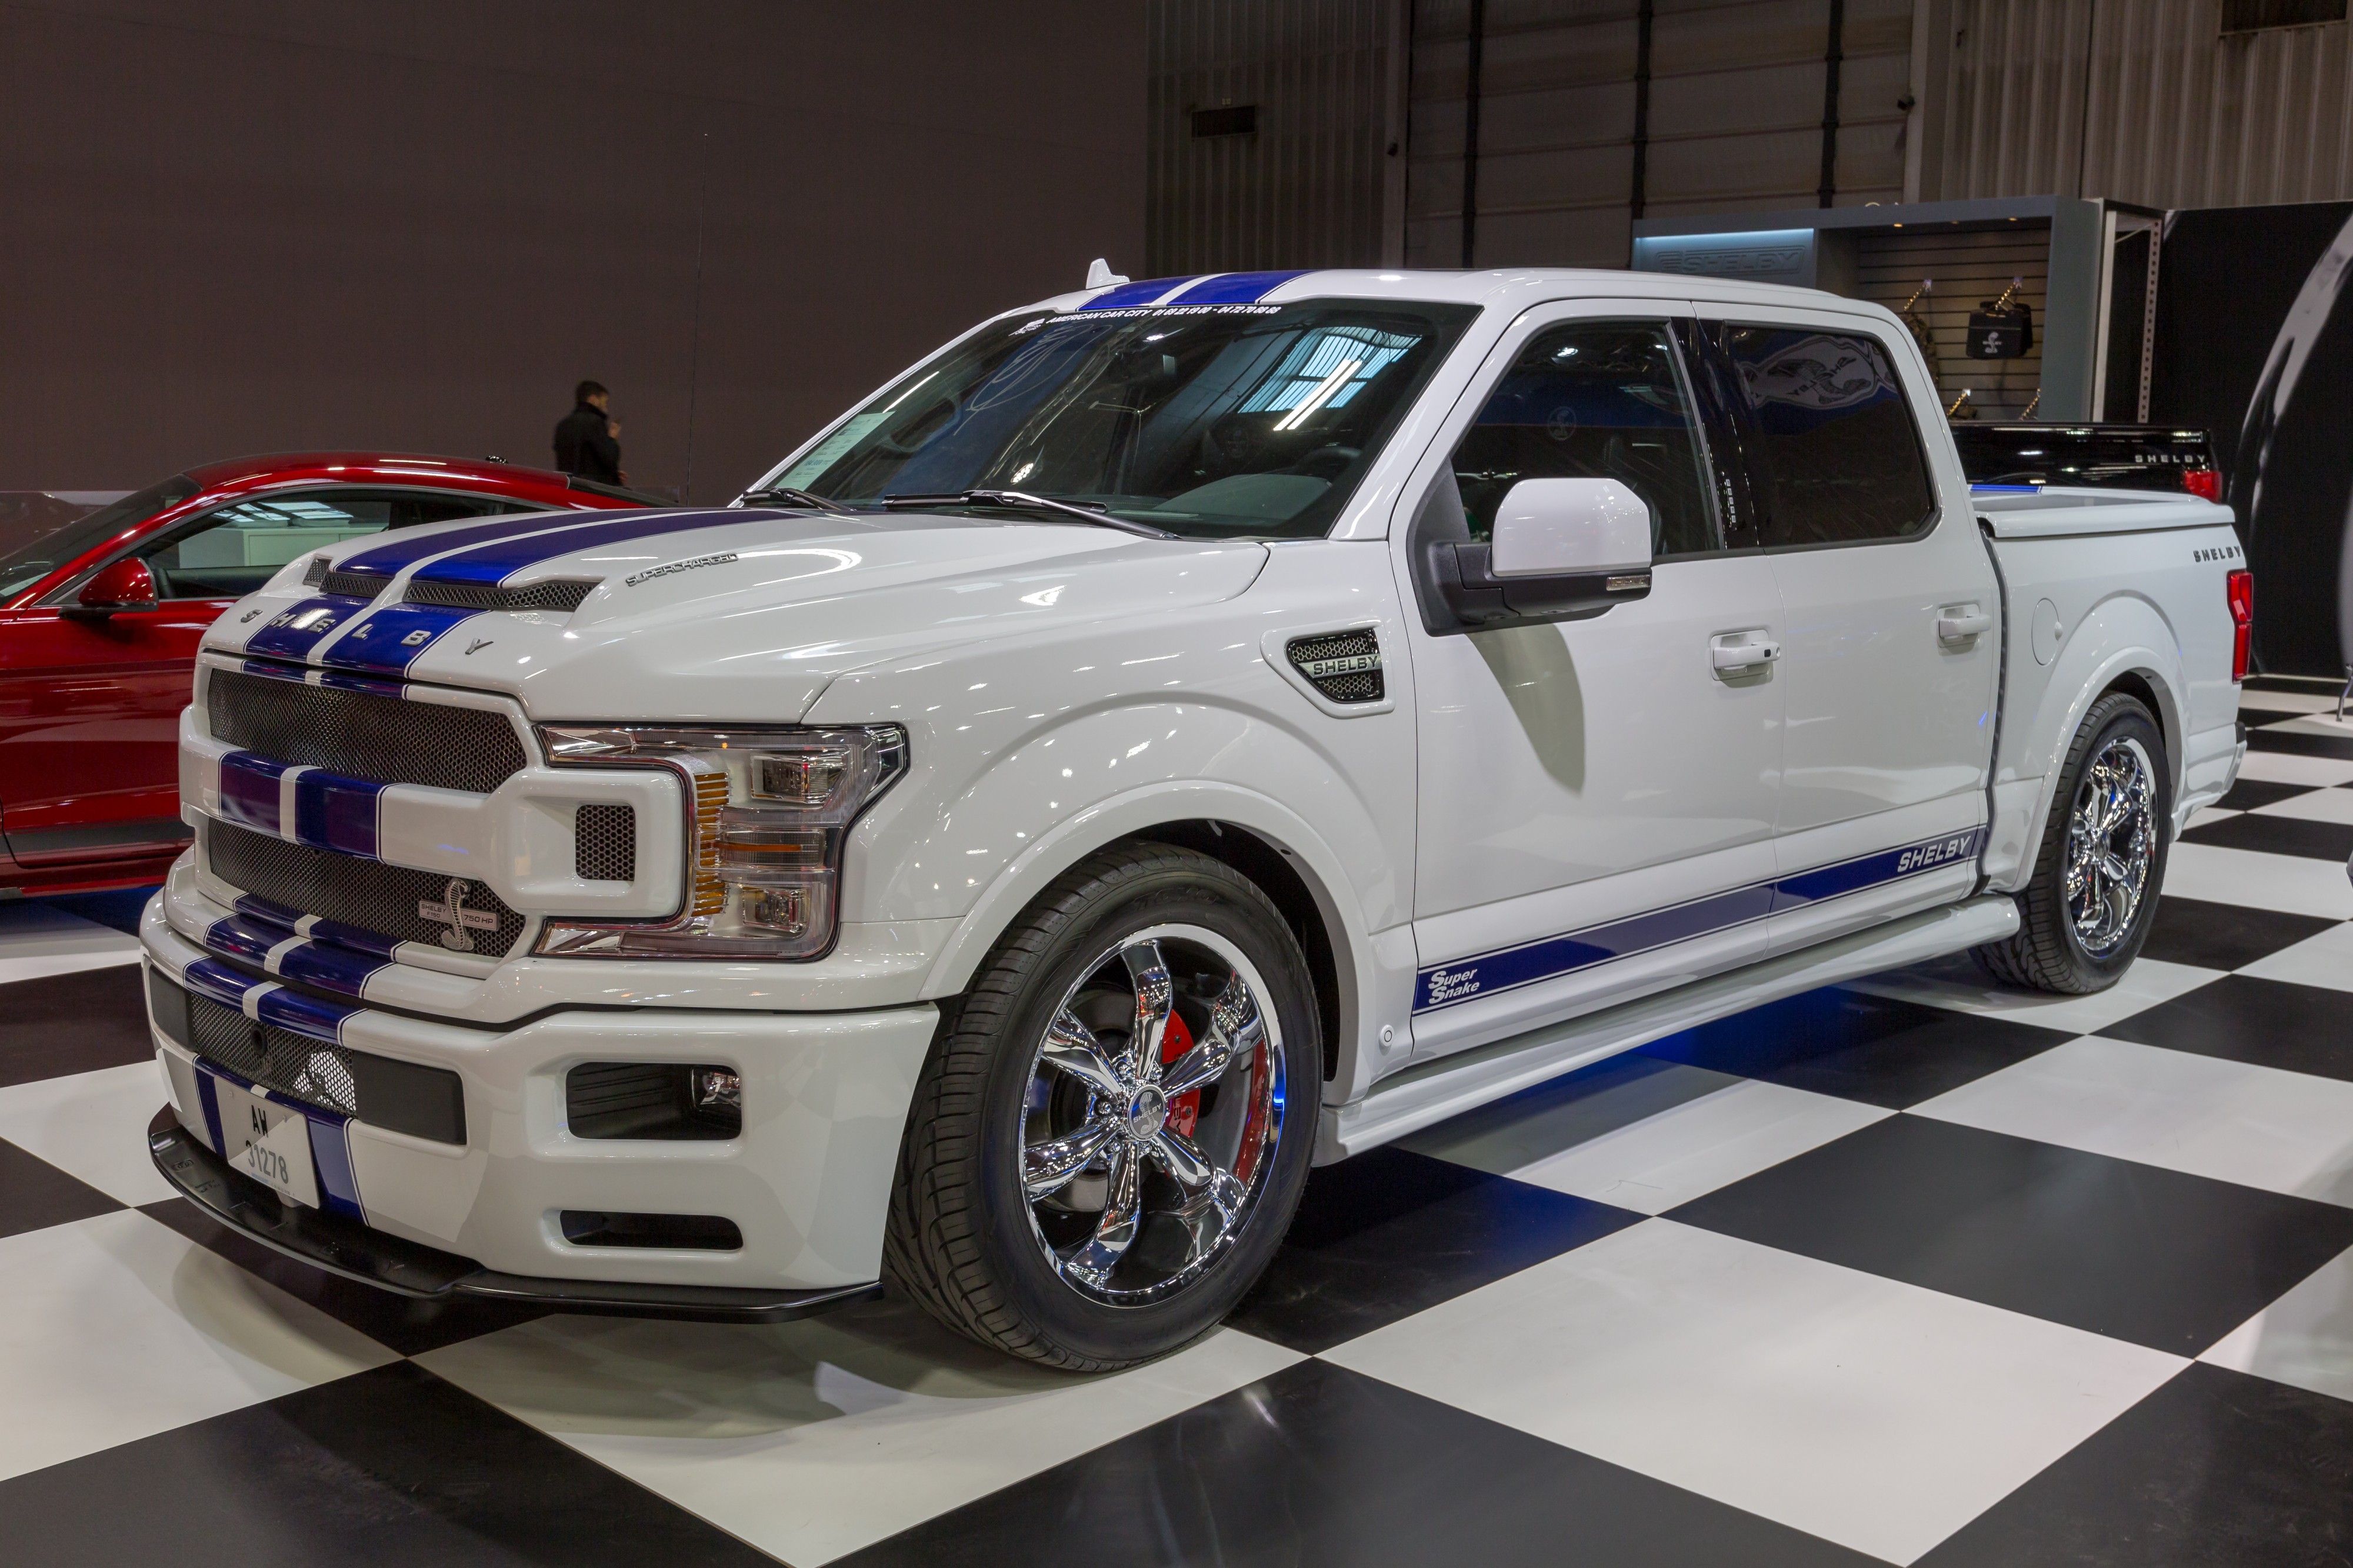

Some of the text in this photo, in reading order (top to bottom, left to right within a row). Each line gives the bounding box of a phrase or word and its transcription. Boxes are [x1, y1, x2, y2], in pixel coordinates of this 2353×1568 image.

[1683, 252, 1799, 273] SHELBY
[1046, 312, 1101, 323] AMERICAN
[2135, 454, 2206, 463] SHELBY
[2193, 546, 2242, 563] SHELBY
[625, 552, 739, 587] SUPERCHARGED
[240, 608, 494, 655] SHELBY
[1313, 655, 1379, 676] SHELBY
[1897, 835, 1971, 873] SHELBY
[421, 903, 447, 913] SHELBY
[463, 914, 480, 923] 750
[1428, 969, 1478, 989] Super
[1429, 982, 1480, 1004] Snake
[251, 1105, 269, 1138] AW
[1133, 1103, 1162, 1123] SHELBY
[245, 1139, 289, 1184] 31278
